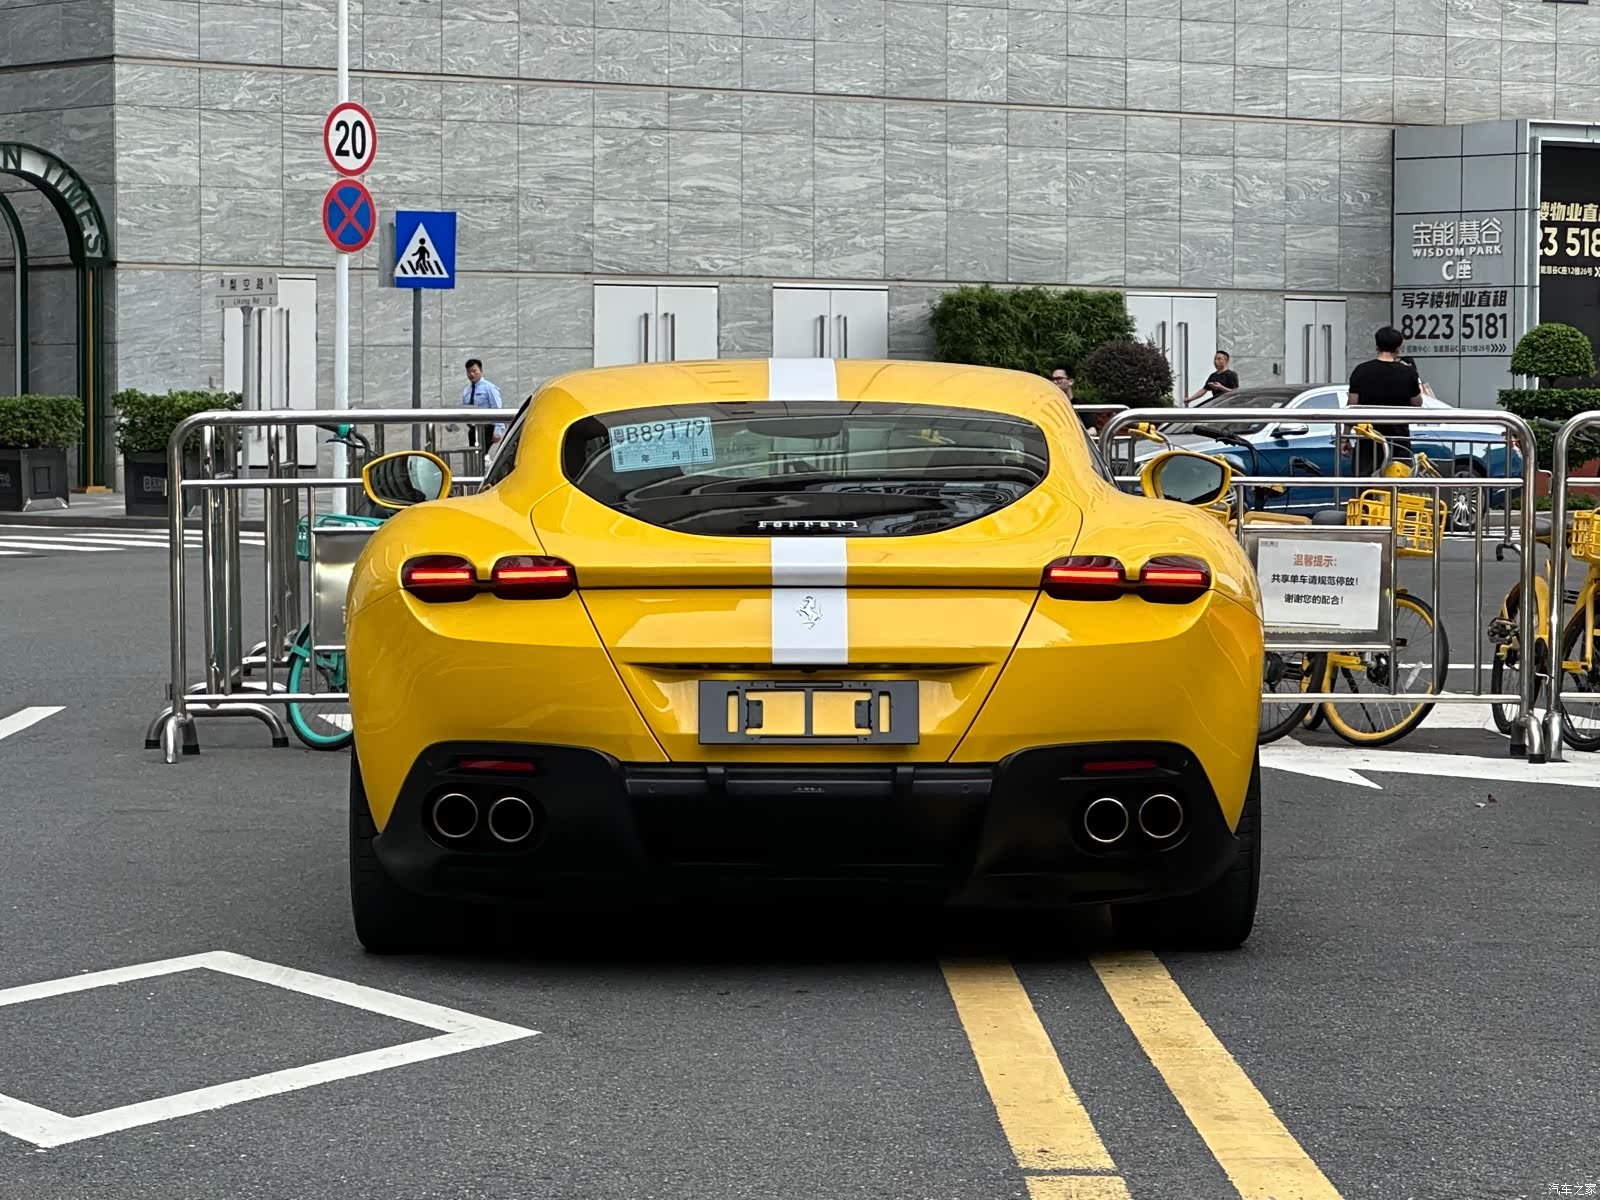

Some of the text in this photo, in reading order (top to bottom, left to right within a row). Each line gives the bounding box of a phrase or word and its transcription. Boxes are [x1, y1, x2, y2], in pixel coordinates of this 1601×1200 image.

[335, 120, 366, 160] 20
[0, 145, 106, 254] N TIMES
[1540, 202, 1600, 222] 楼物业直
[1412, 245, 1502, 257] WISDOM PARK
[1540, 227, 1558, 256] 3
[1442, 259, 1472, 281] C座
[1401, 290, 1507, 309] 写字楼物业直租
[1401, 312, 1507, 340] 8223 5181
[1271, 573, 1359, 587] 共享单车请规范停放！
[1284, 593, 1344, 606] 谢谢您的配合！
